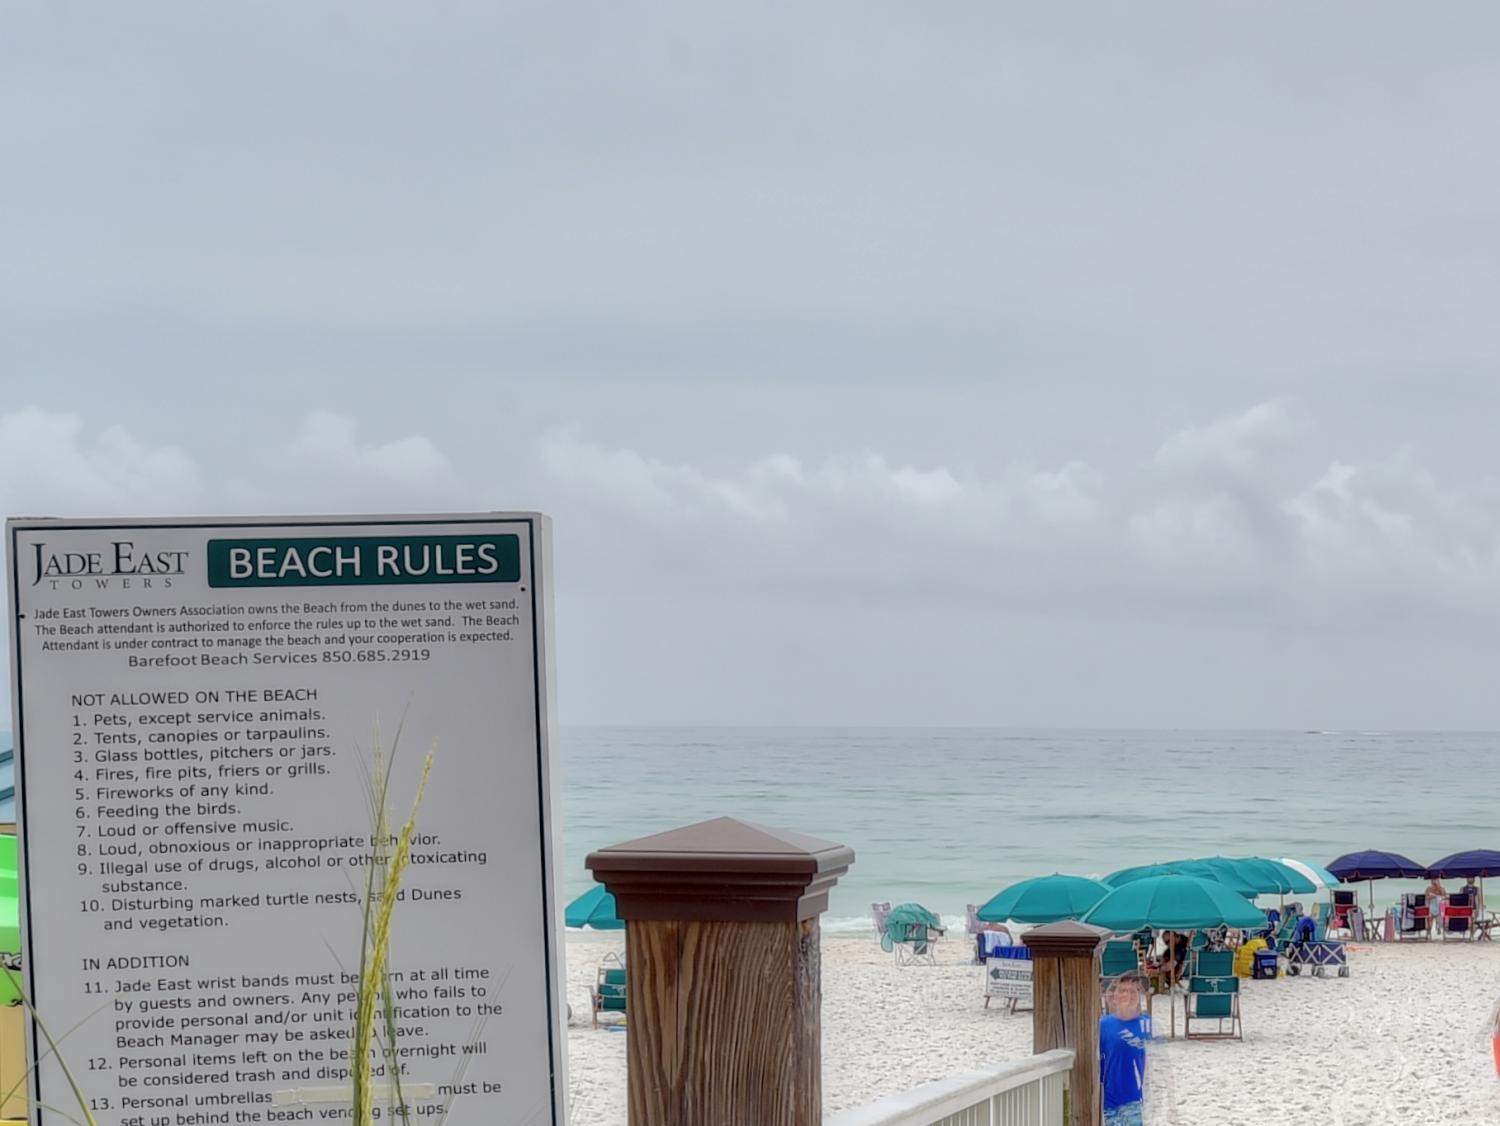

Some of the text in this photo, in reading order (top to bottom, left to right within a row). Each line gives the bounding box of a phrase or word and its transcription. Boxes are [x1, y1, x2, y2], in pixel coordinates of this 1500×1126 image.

[229, 543, 498, 579] BEACH RULES
[49, 578, 171, 590] TOWERS
[34, 598, 519, 619] Jade East Towers Owners Association owns the Beach from the dunes the wet sand.
[34, 614, 519, 636] The Beach attendant authorized enforce the rules the wet sand. The Beach
[41, 629, 514, 651] Attendant under contract manage the beach and your cooperation expected.
[128, 649, 430, 667] Barefoot Beach Services 850.685.2919
[71, 688, 317, 707] NOT ALLOWED ON THE BEACH
[94, 707, 326, 728] Pets, except service animals.
[93, 726, 330, 746] Tents, canopies tarpaulins.
[95, 744, 336, 763] Glass bottles, pitchers jars.
[96, 761, 331, 782] Fires, fire pits, friers grills.
[96, 782, 274, 800] Fireworks any kind.
[97, 801, 241, 820] Feeding the birds.
[98, 819, 294, 837] Loud offensive music.
[99, 841, 142, 857] Loud,
[148, 839, 230, 854] obnoxious
[258, 835, 365, 853] inappropriate
[99, 852, 390, 877] Illegal use drugs, alcohol other
[101, 880, 187, 893] substance.
[111, 896, 194, 912] Disturbing
[200, 893, 260, 908] marked
[265, 891, 309, 906] turtle
[315, 891, 362, 907] nests,
[411, 888, 461, 901] Dunes
[103, 914, 229, 932] and vegetation.
[82, 954, 190, 971] IN ADDITION
[114, 967, 490, 993] Jade East wrist bands must all time
[139, 985, 466, 1013] guests and owners. Any who fails
[115, 1002, 503, 1033] provide personal and/or unit the
[116, 1027, 355, 1048] Beach Manager may asked
[119, 1040, 487, 1069] Personal items left the overnight will
[143, 1066, 310, 1087] considered trash and
[121, 1082, 476, 1110] Personal umbrellas must
[176, 1110, 230, 1126] behind
[235, 1110, 262, 1123] the
[267, 1107, 313, 1122] beach
[416, 1103, 449, 1118] ups.
